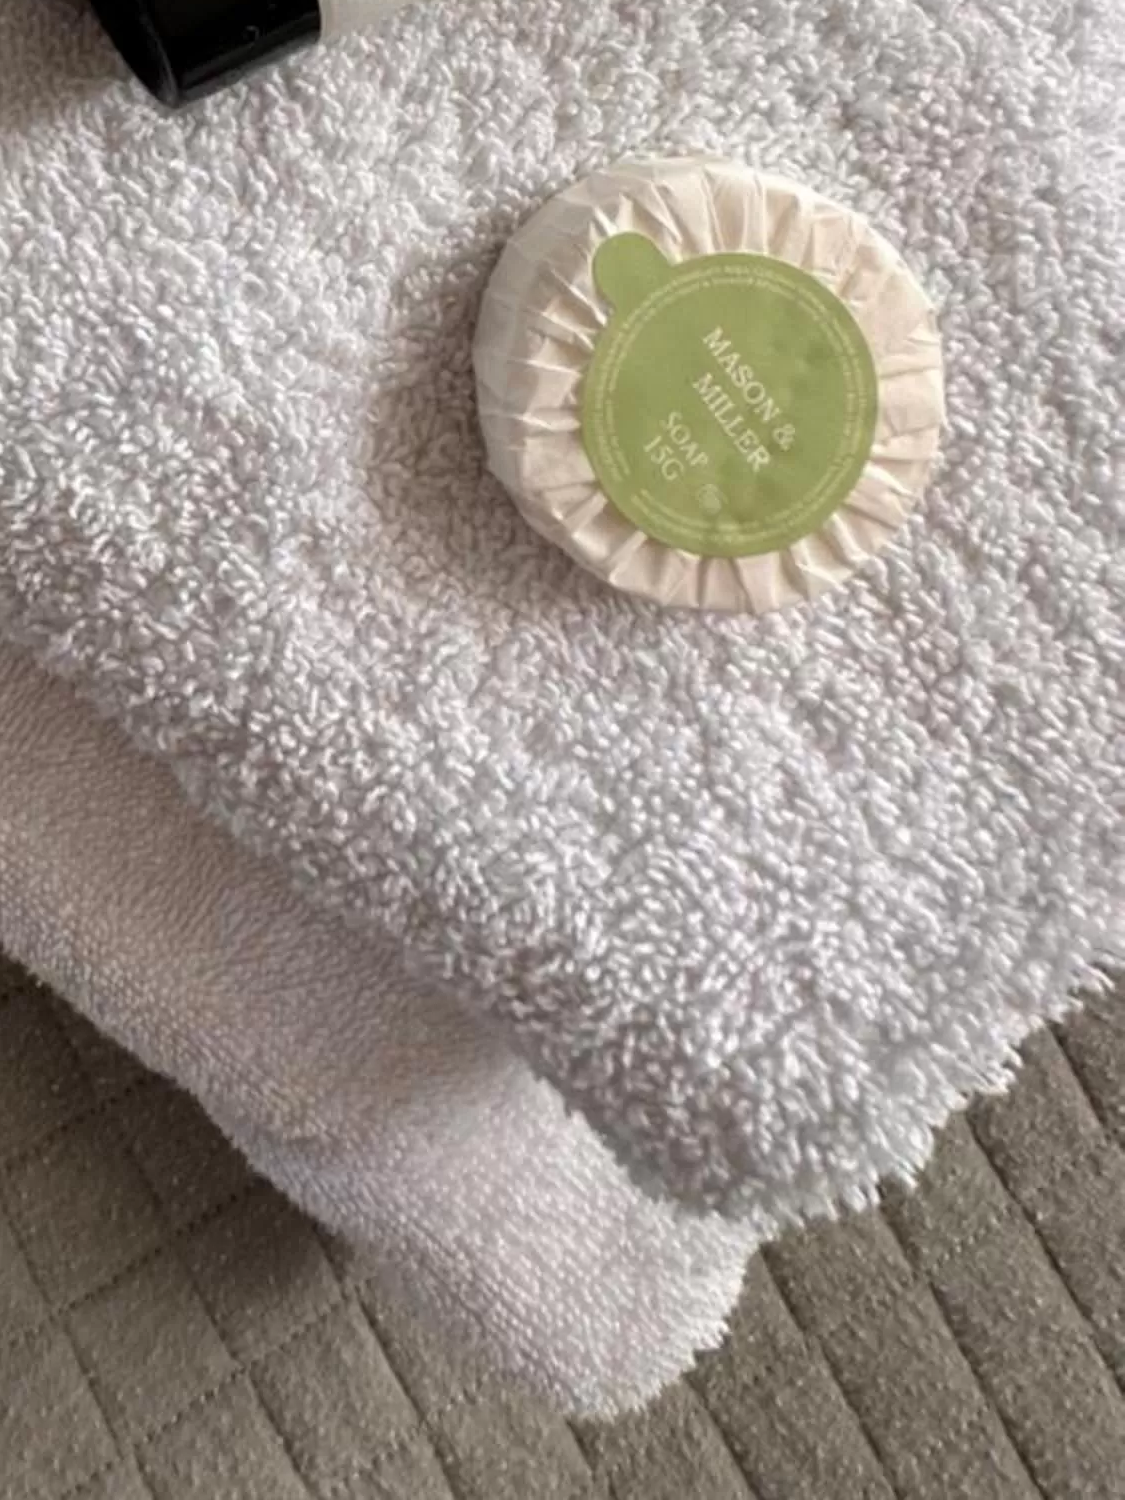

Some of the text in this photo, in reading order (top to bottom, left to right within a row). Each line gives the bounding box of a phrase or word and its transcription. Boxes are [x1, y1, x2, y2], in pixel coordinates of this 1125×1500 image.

[692, 372, 770, 472] MILLER
[702, 326, 796, 452] MASON &
[643, 435, 685, 480] 15G
[661, 411, 708, 469] SOAP
